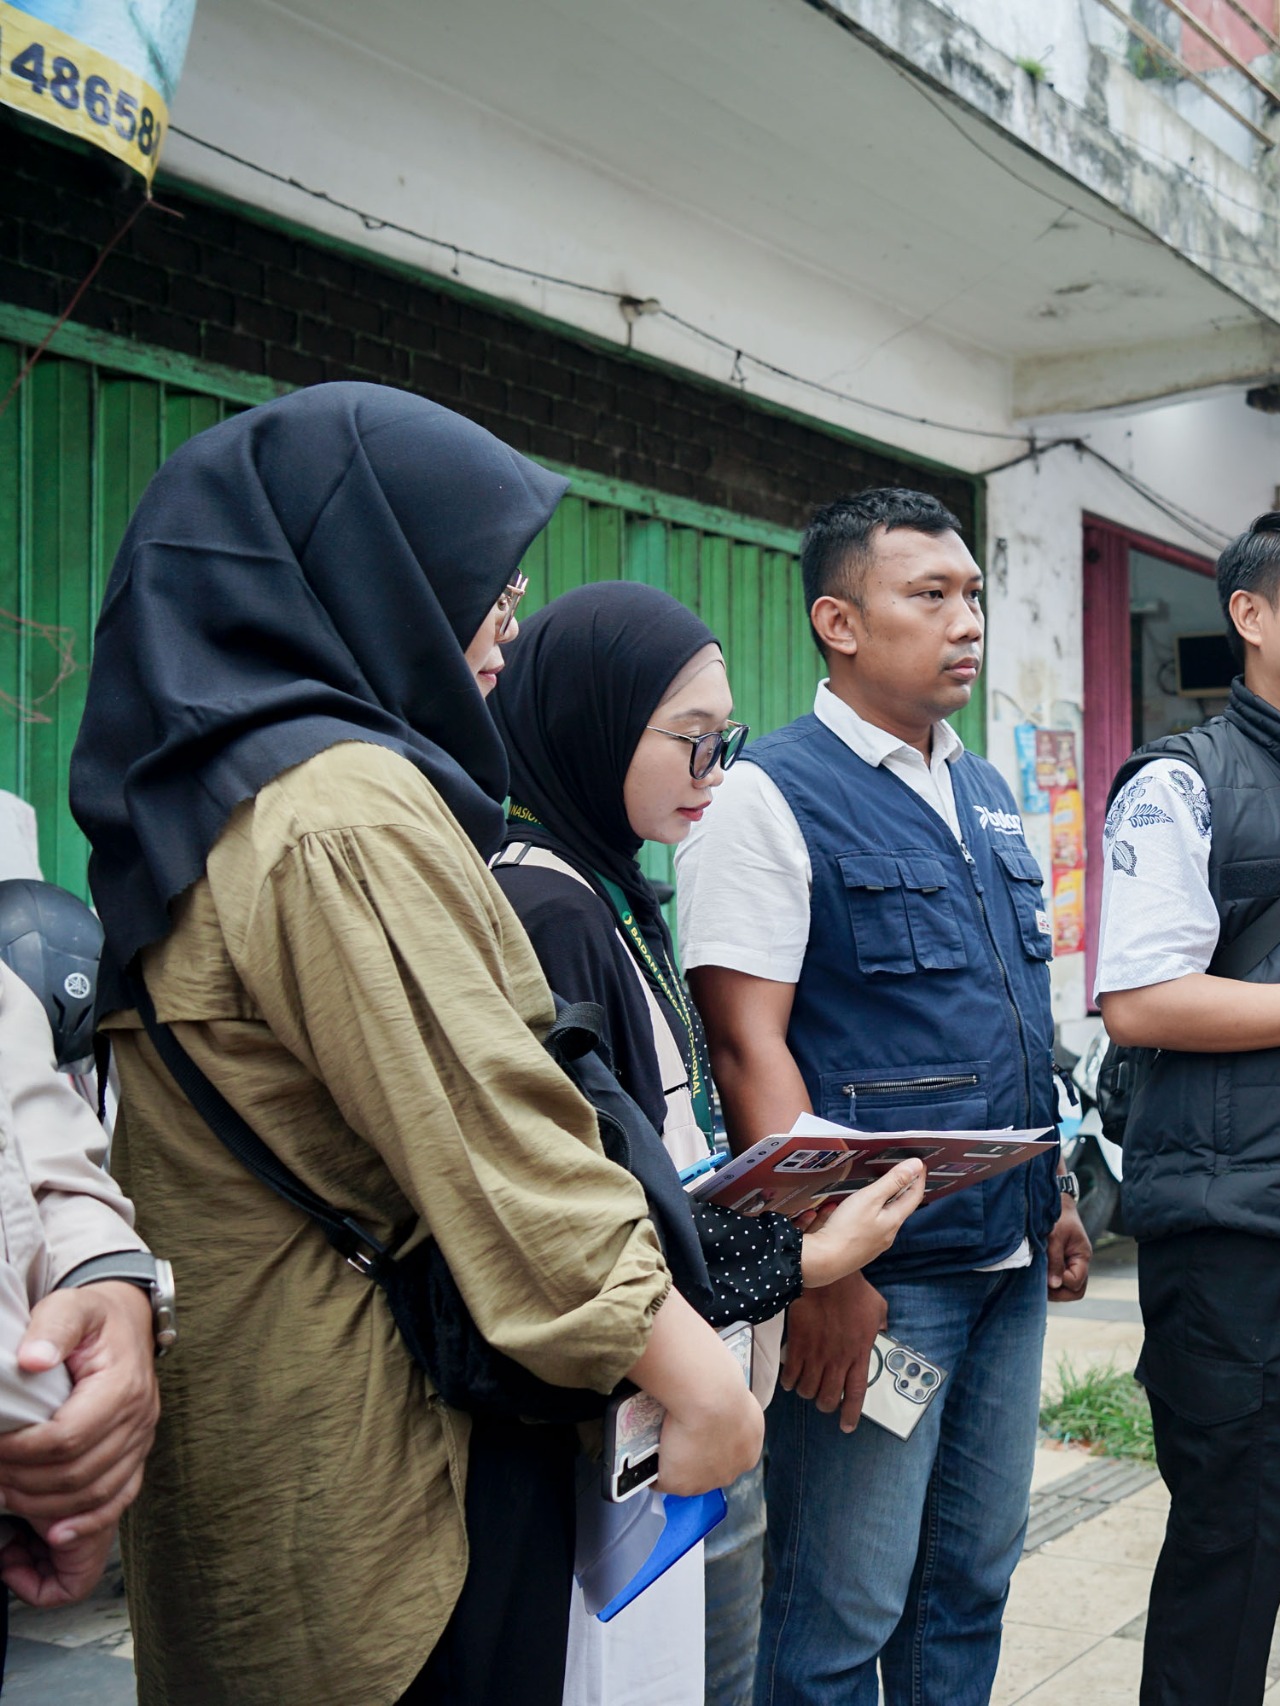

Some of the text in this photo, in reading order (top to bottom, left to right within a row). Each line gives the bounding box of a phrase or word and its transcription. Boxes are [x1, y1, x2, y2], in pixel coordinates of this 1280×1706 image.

[0, 27, 161, 164] 48658
[509, 803, 542, 825] NASIO
[630, 927, 658, 973] BADAN
